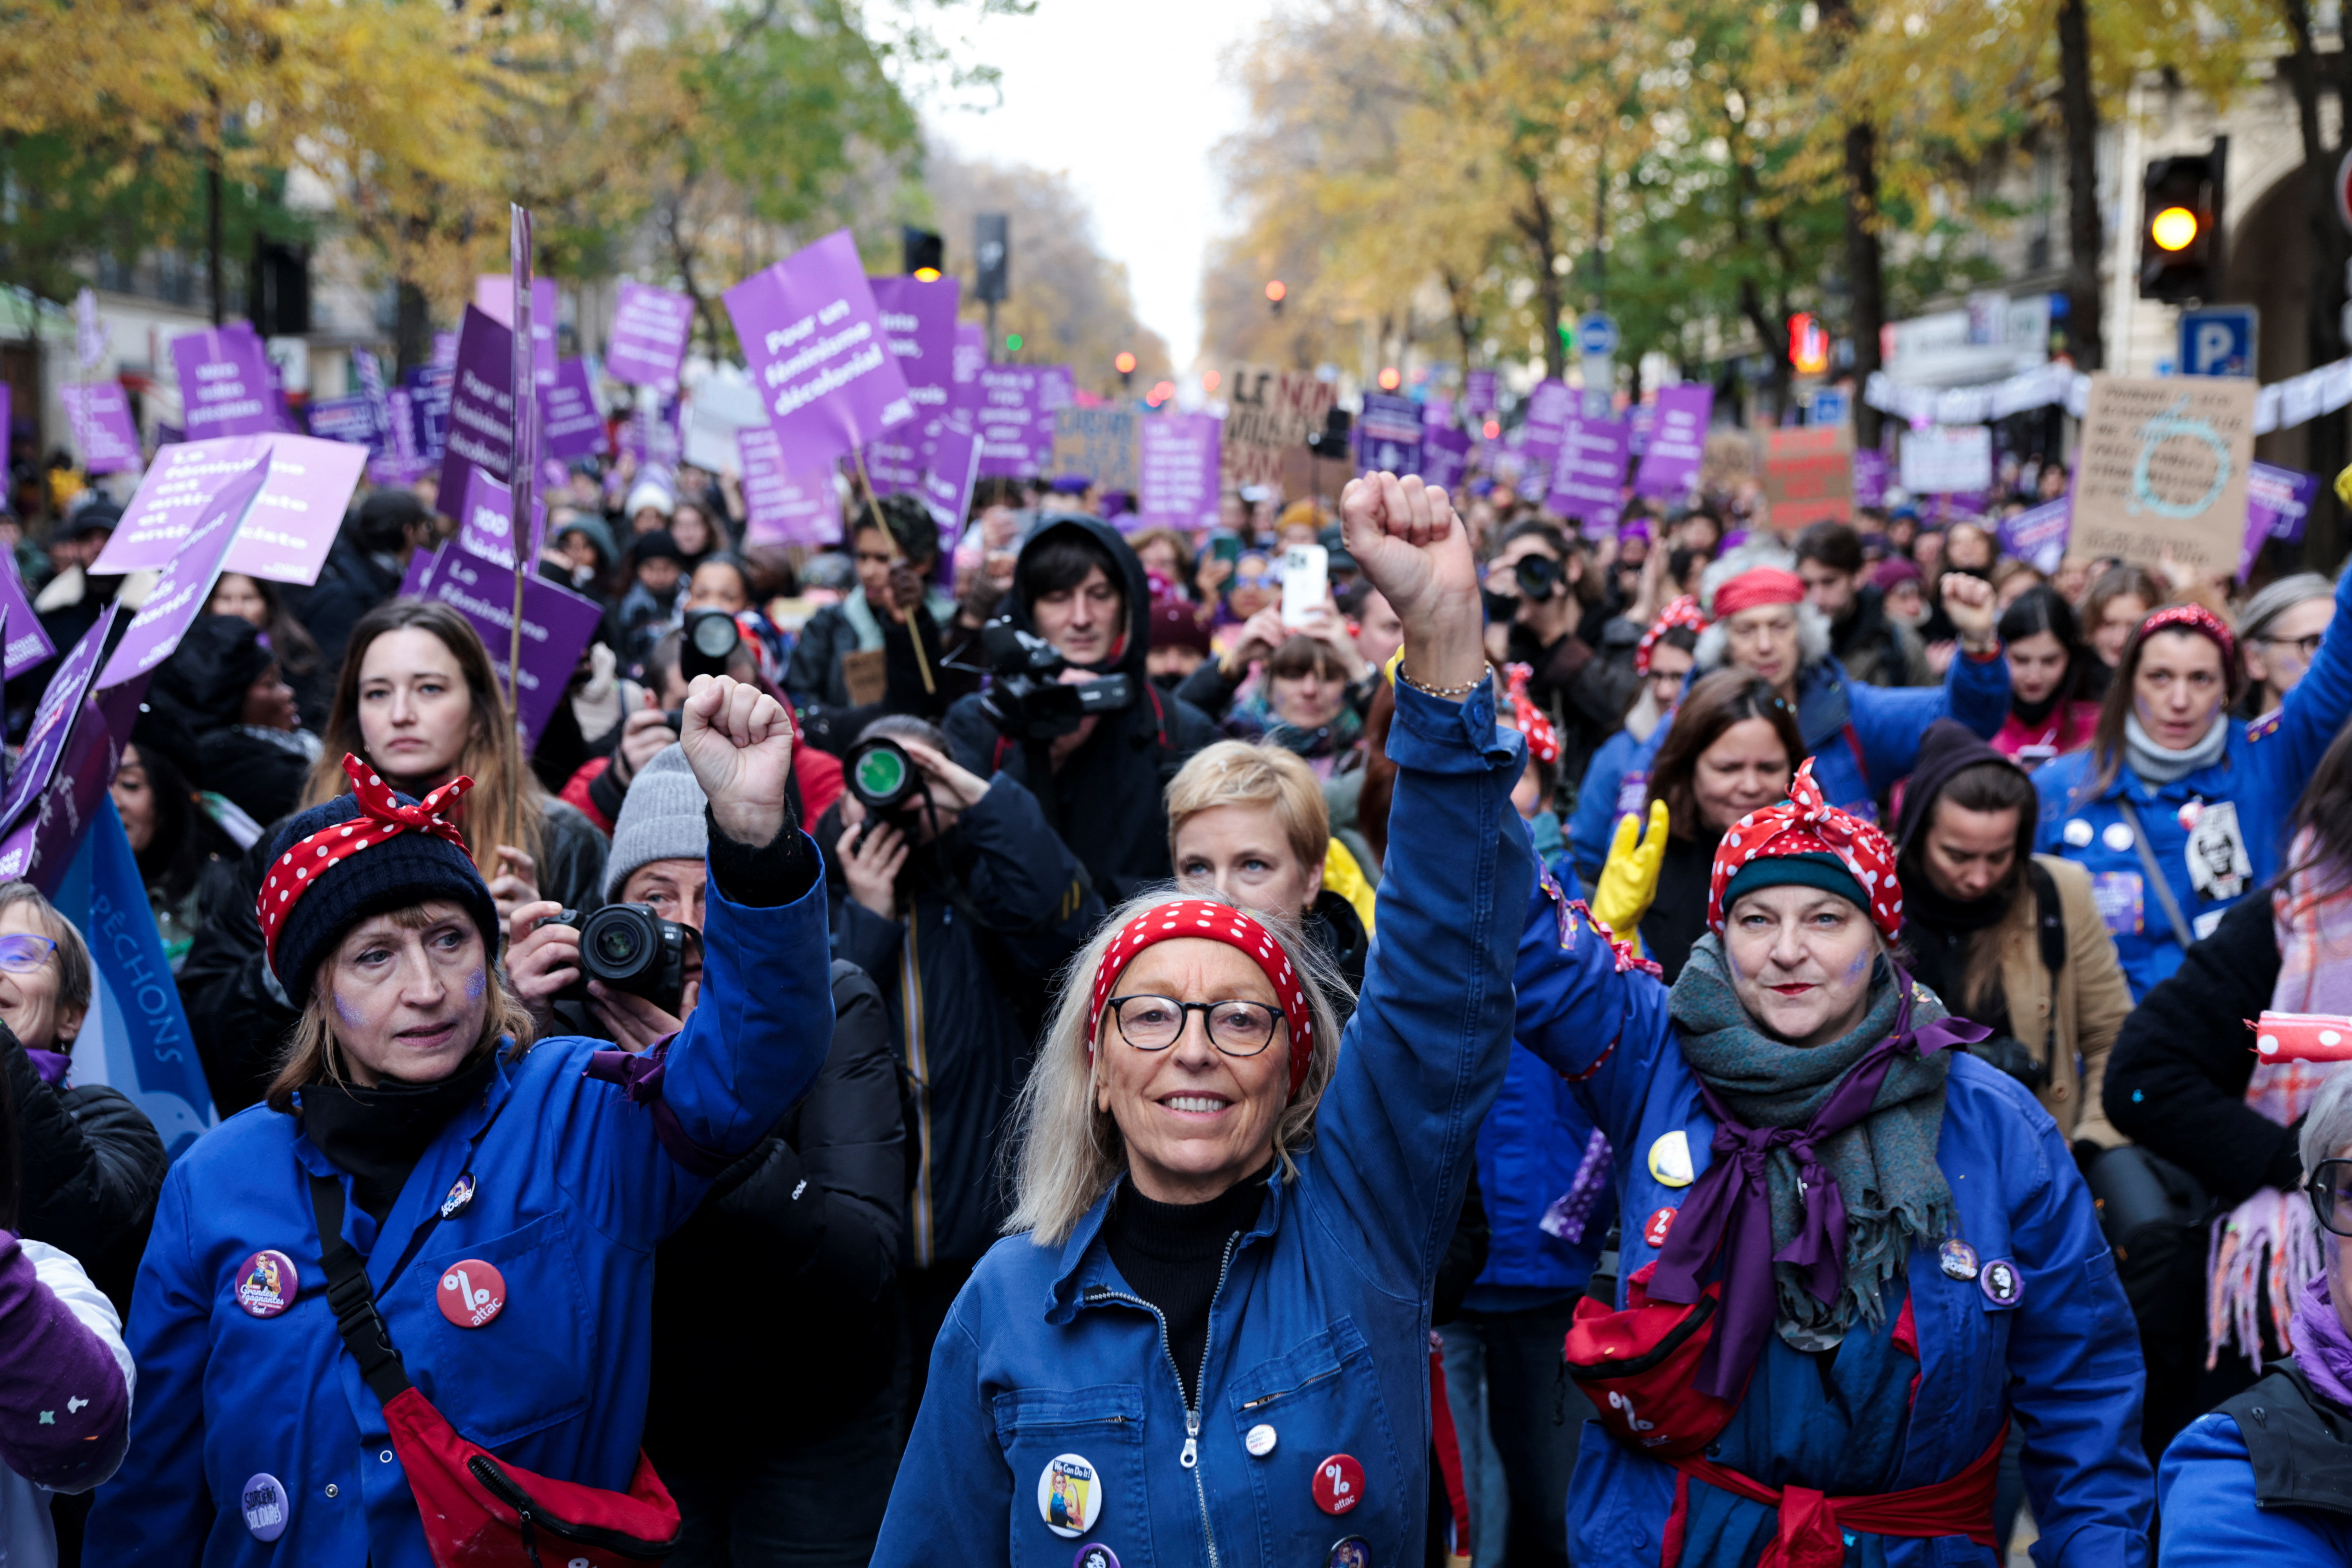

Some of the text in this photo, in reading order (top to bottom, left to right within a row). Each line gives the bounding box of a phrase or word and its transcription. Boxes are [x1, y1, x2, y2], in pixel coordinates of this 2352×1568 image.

[765, 298, 851, 356] Pour un
[765, 320, 872, 389] féminisme
[774, 342, 884, 416] décolonial
[449, 558, 479, 586] Le
[240, 1284, 274, 1299] Grandes
[244, 1294, 284, 1306] gagnantes
[471, 1297, 502, 1326] attac
[1054, 1461, 1063, 1471] We
[1063, 1463, 1074, 1474] Can
[1074, 1467, 1083, 1477] Do
[1334, 1495, 1355, 1511] attac
